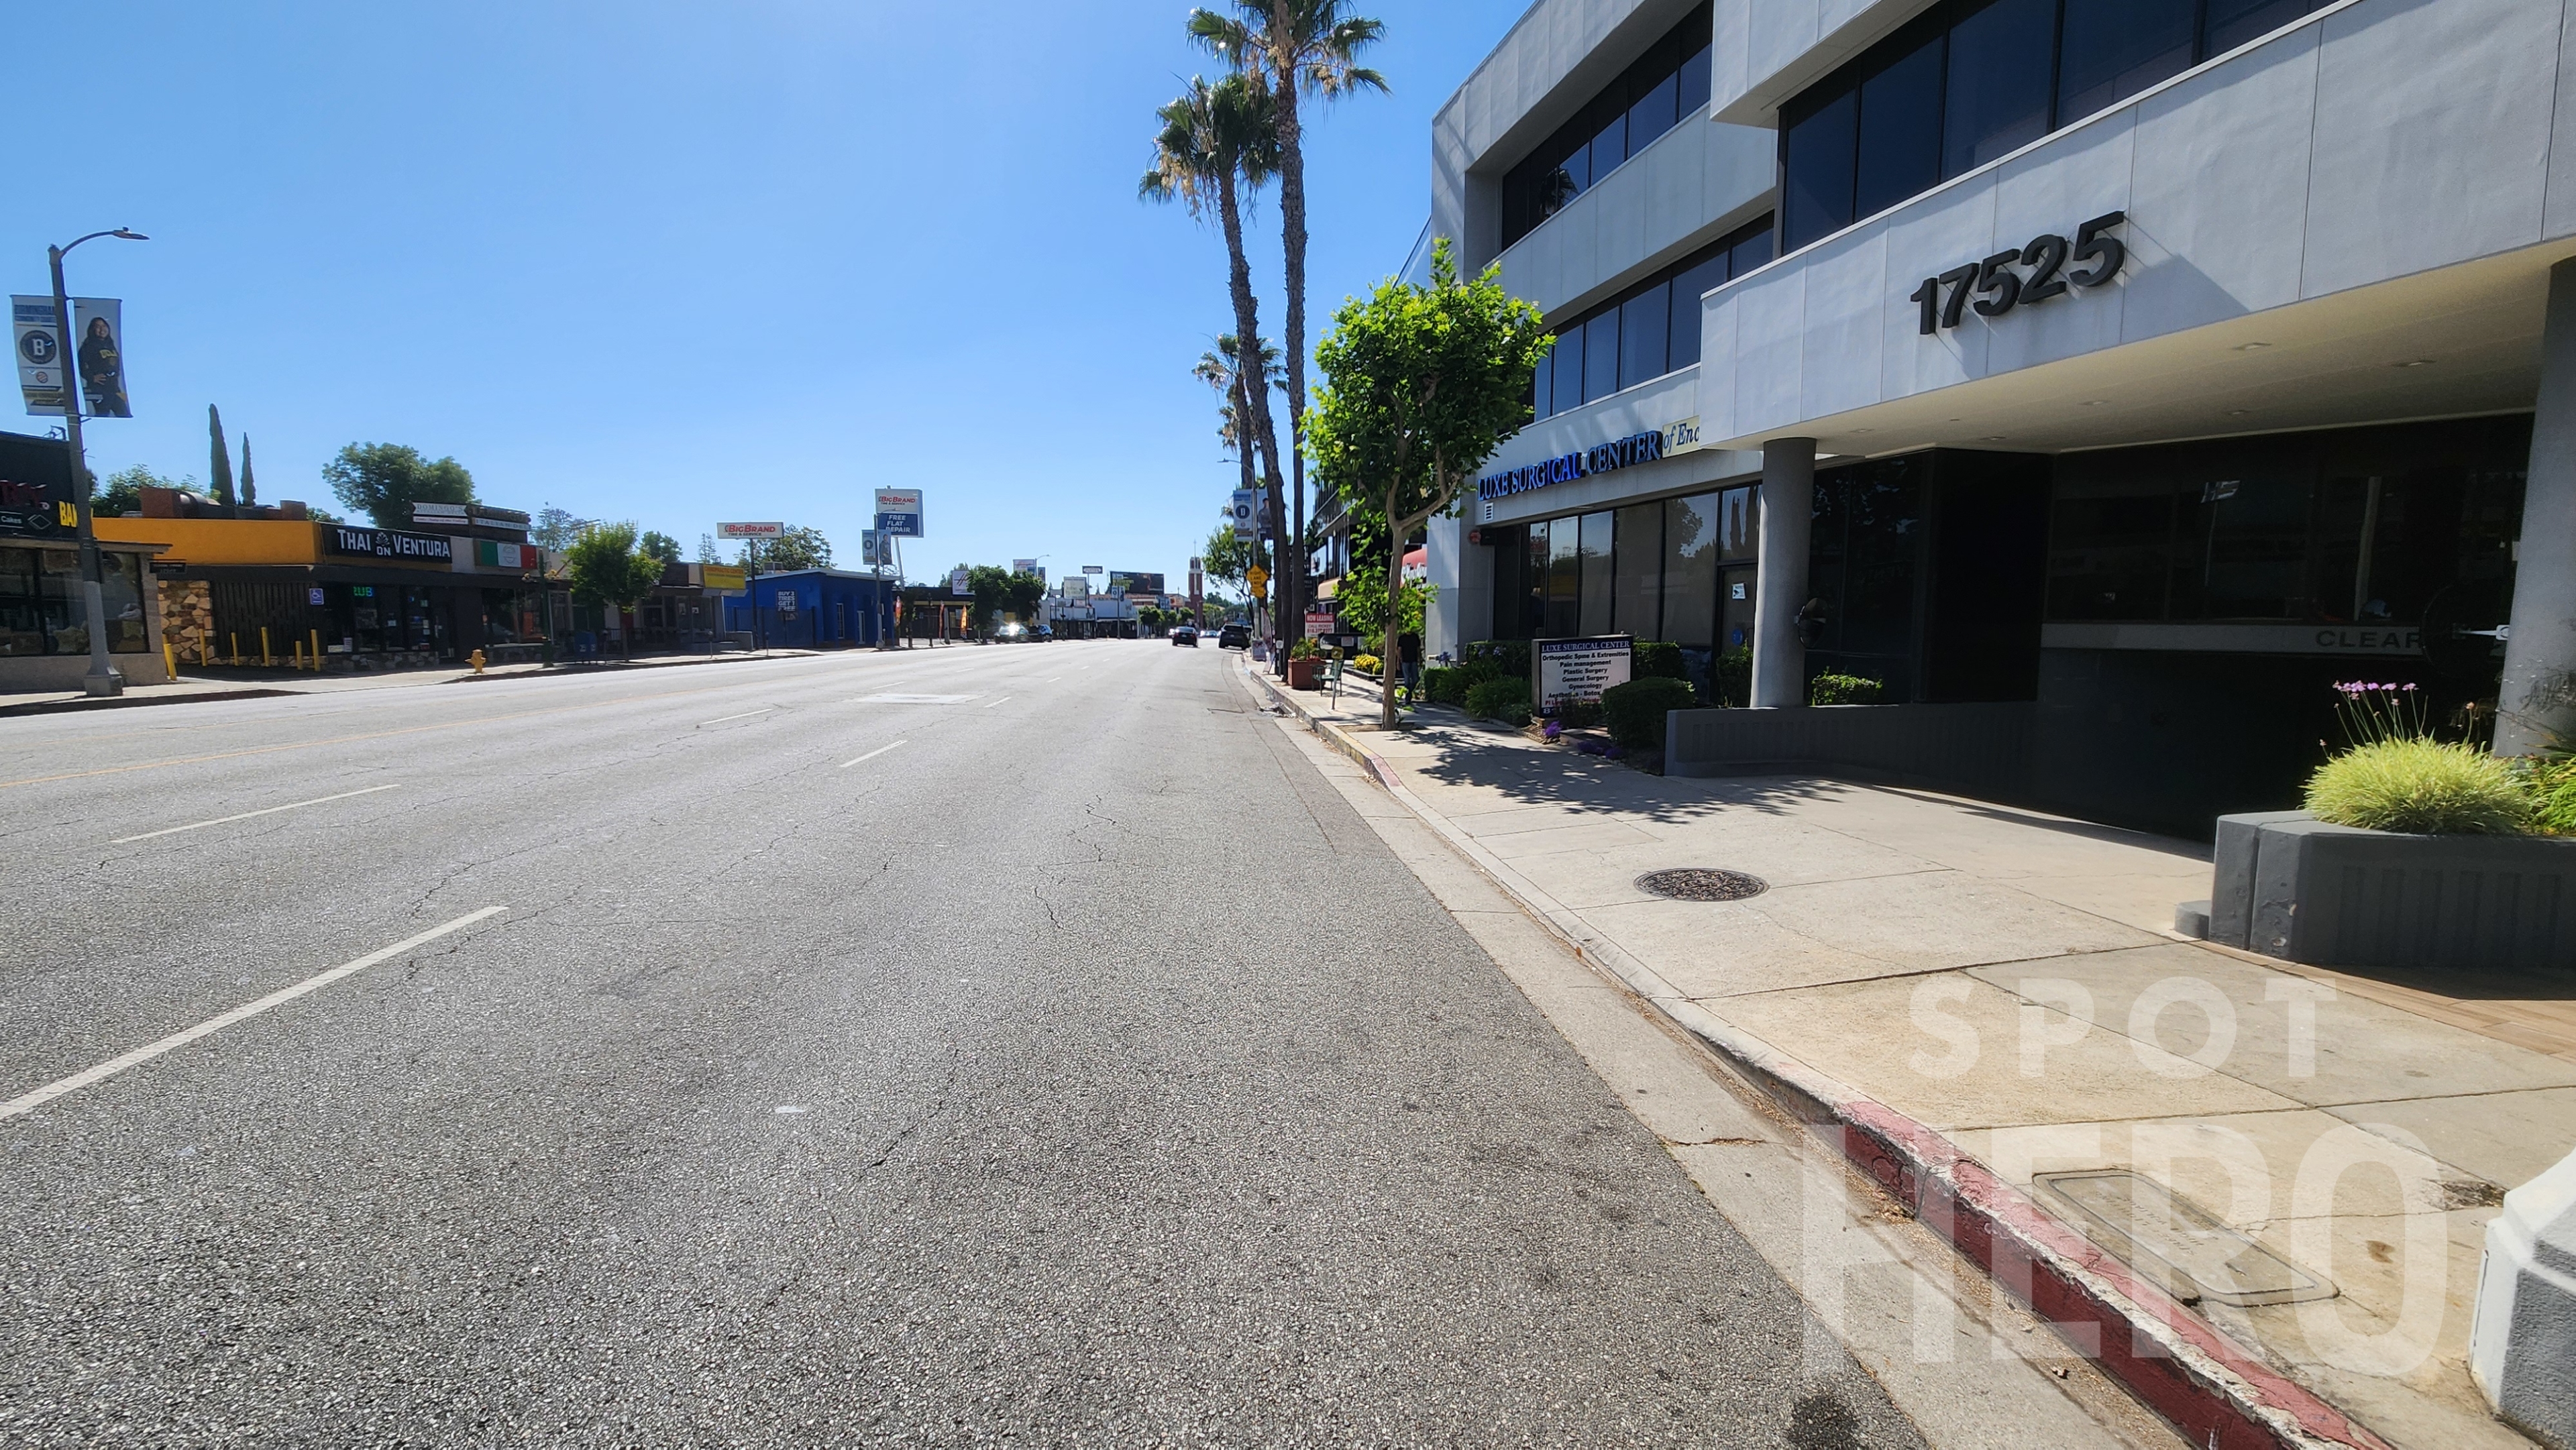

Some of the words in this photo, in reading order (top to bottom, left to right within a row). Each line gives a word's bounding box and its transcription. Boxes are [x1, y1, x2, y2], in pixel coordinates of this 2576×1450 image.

[1910, 210, 2125, 335] 17525
[32, 338, 46, 356] B
[1477, 471, 1509, 502] LUXE
[1511, 451, 1582, 494] SURGICAL
[1585, 430, 1662, 476] CENTER
[1663, 425, 1676, 450] of
[476, 518, 511, 527] ITALIAN
[337, 528, 372, 551] THAI
[376, 546, 391, 557] ON
[392, 534, 451, 558] VENTURA
[1542, 645, 1562, 653] LUXE
[1562, 643, 1600, 651] SURGICAL
[1600, 640, 1630, 649] CENTER
[1542, 653, 1573, 661] Orthopedic
[1573, 659, 1611, 668] management
[1568, 683, 1603, 691] Gynecology
[1548, 691, 1578, 699] Aesthetis
